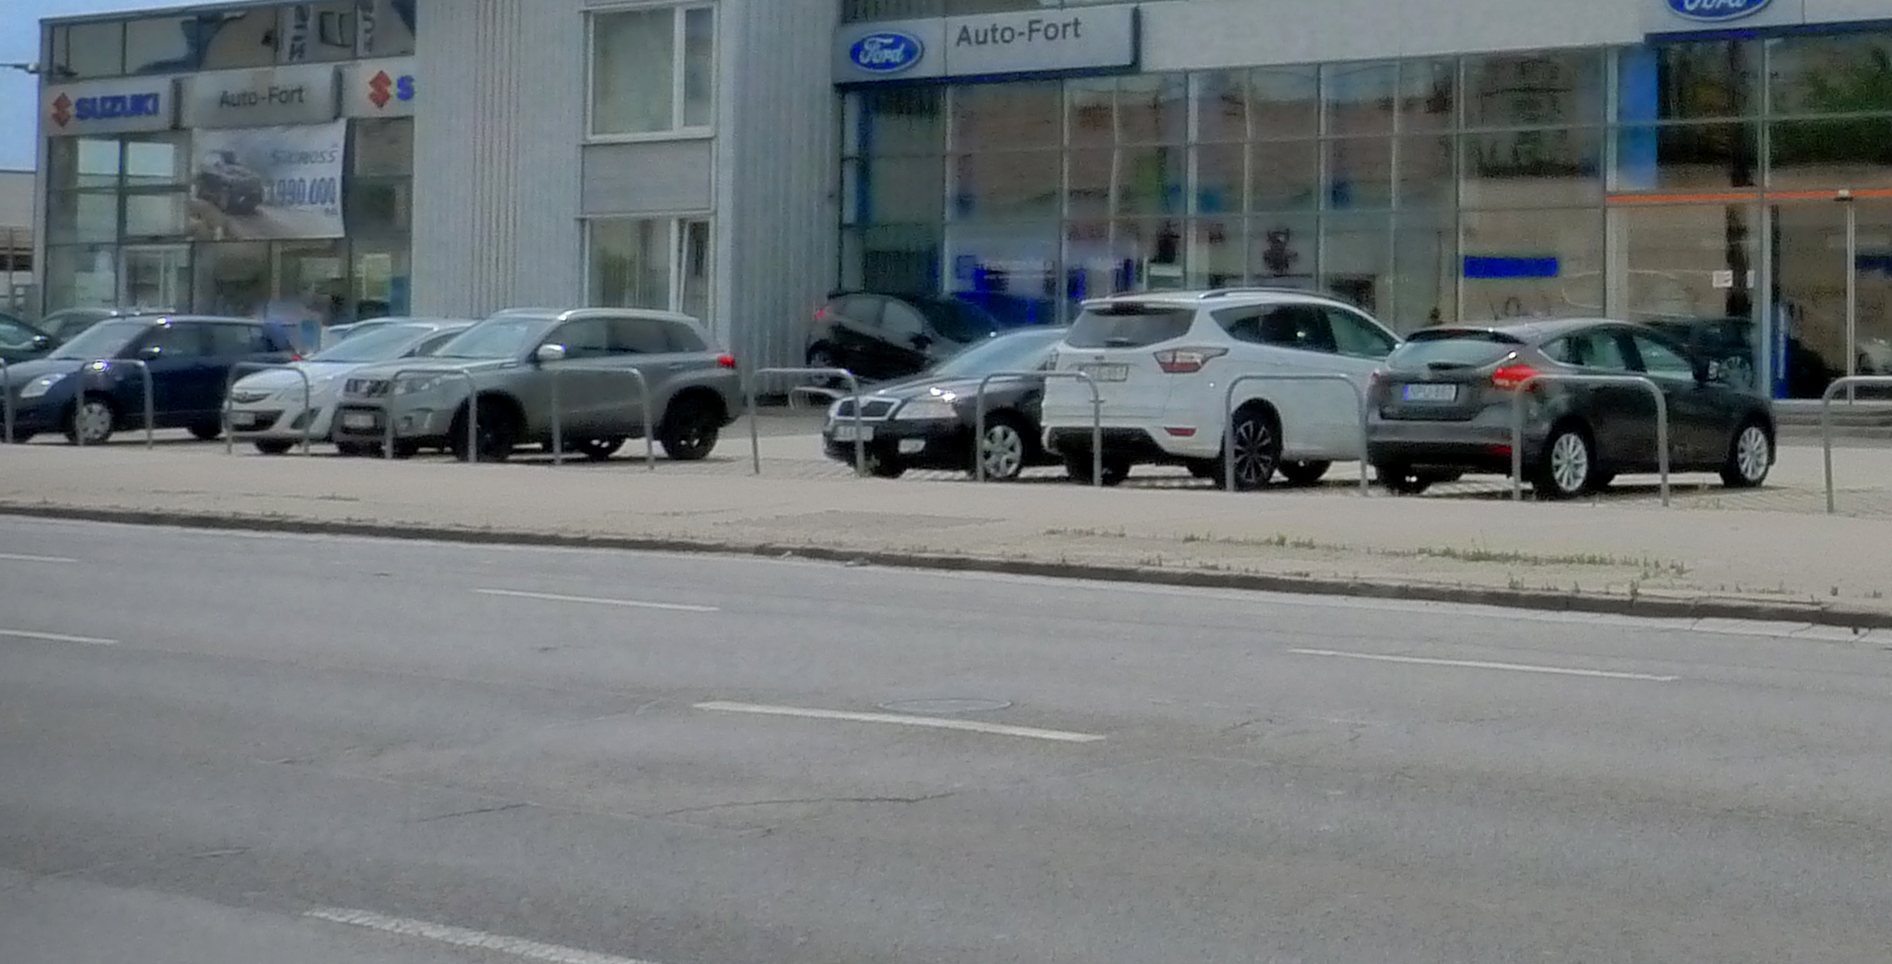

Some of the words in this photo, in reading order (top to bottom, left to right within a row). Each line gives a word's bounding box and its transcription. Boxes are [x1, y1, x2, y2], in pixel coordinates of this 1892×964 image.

[956, 17, 1083, 47] Auto-Fort
[858, 37, 906, 65] Ford
[75, 92, 160, 120] SUZUKI
[219, 86, 305, 108] Auto-Fort
